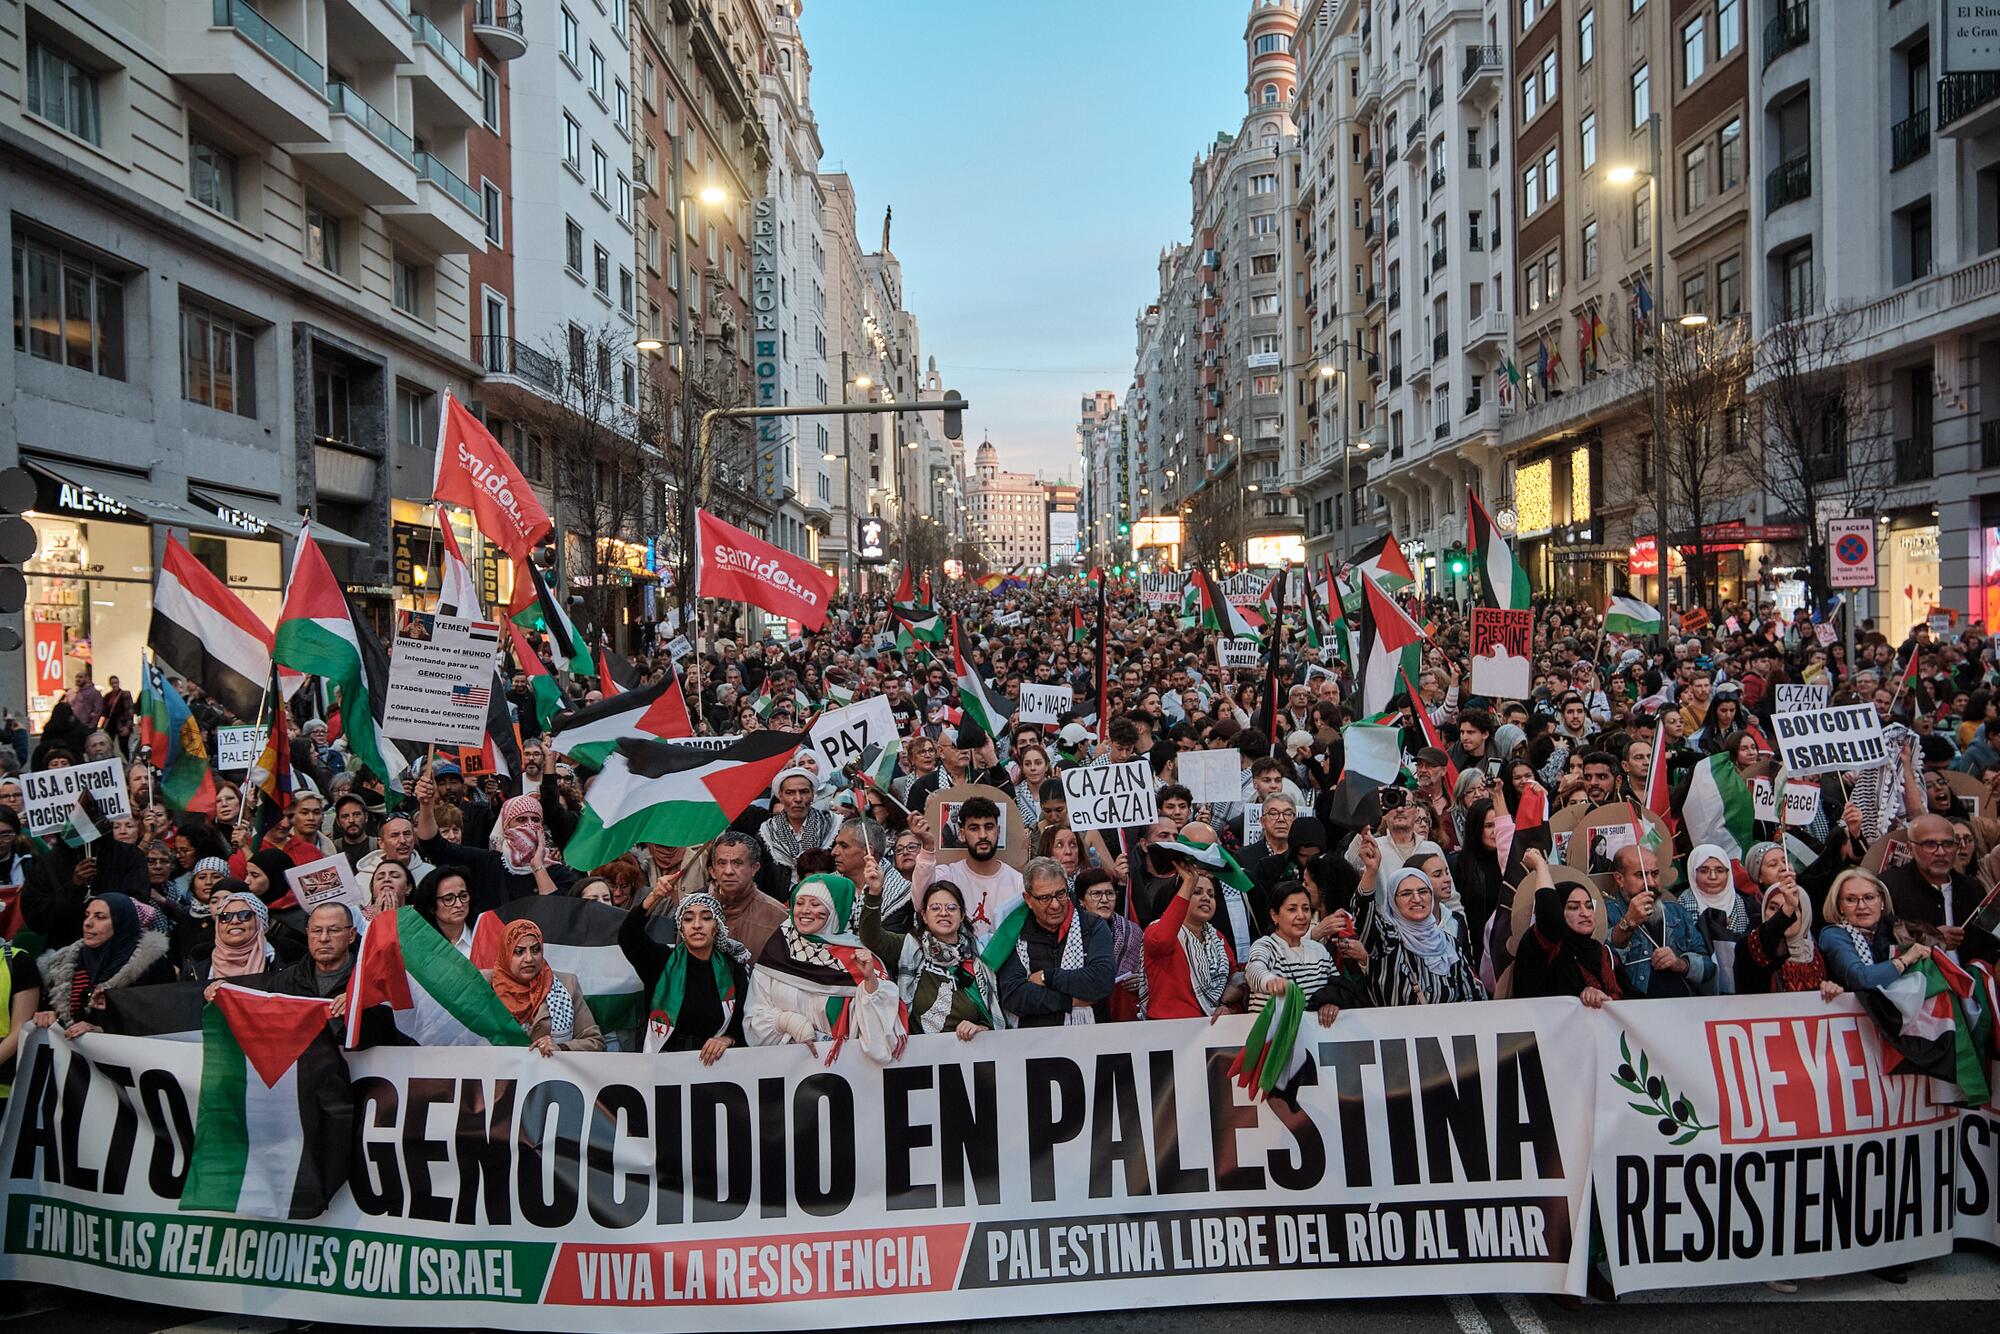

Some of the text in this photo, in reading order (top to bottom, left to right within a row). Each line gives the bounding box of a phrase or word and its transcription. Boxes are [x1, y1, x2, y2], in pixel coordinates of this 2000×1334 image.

[1958, 7, 1970, 17] El
[1957, 27, 1997, 37] de Gran
[754, 201, 777, 442] SENATOR HOTL
[484, 547, 497, 602] TACOS
[436, 622, 469, 633] YEMEN
[1476, 611, 1529, 625] FREE FREE
[462, 650, 491, 659] MUNDO
[1223, 641, 1256, 651] BOYCOTT
[404, 655, 446, 666] intentando
[447, 661, 468, 670] parar
[418, 669, 462, 681] GENOCIDIO
[391, 684, 451, 697] ESTADOS UNIDOS
[1021, 692, 1035, 713] NO
[1044, 694, 1072, 715] WAR!
[1777, 685, 1823, 702] CAZAN
[442, 710, 480, 720] GENOCIDIO
[1778, 708, 1873, 739] BOYCOTT
[821, 719, 880, 768] PAZ
[1786, 737, 1885, 769] ISRAEL!!!
[26, 775, 63, 800] U.S.A.
[65, 776, 74, 793] e
[1066, 763, 1146, 798] CAZAN
[1072, 791, 1155, 824] en GAZA!
[1714, 1022, 1798, 1140] DE
[10, 1031, 1565, 1229] ALTO GENOCIDIO EN PALESTINA
[1616, 1134, 1923, 1266] RESISTENCIA
[27, 1204, 522, 1297] FIN DE LAS RELACIONES CON ISRAEL
[987, 1202, 1549, 1281] PALESTINA LIBRE DEL RÍO AL MAR
[577, 1235, 932, 1300] VIVA LA RESISTENCIA
